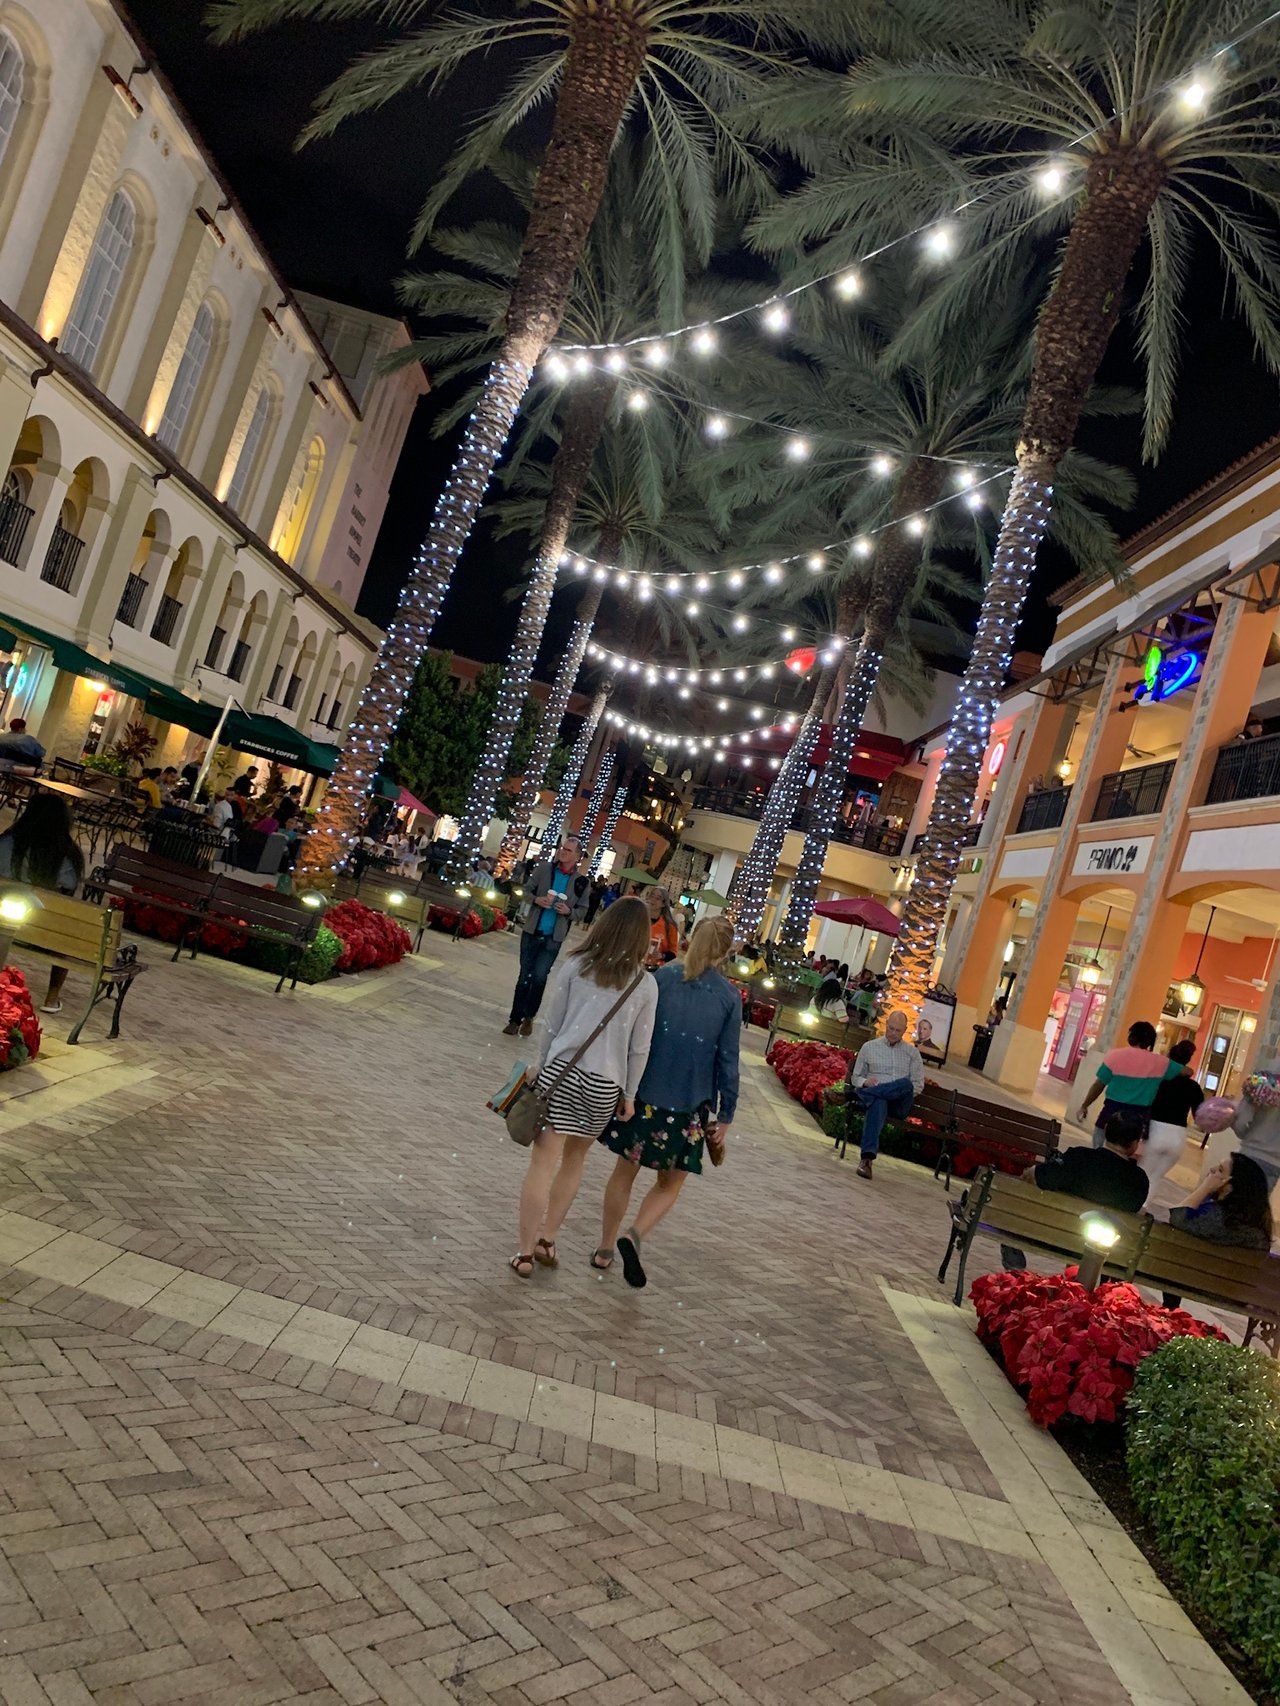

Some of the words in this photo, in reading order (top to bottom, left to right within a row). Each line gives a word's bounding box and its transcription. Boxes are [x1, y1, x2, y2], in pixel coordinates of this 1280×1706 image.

[239, 738, 275, 754] STARBUCKS
[275, 749, 299, 761] COFFEE
[1087, 846, 1124, 870] PRIMO
